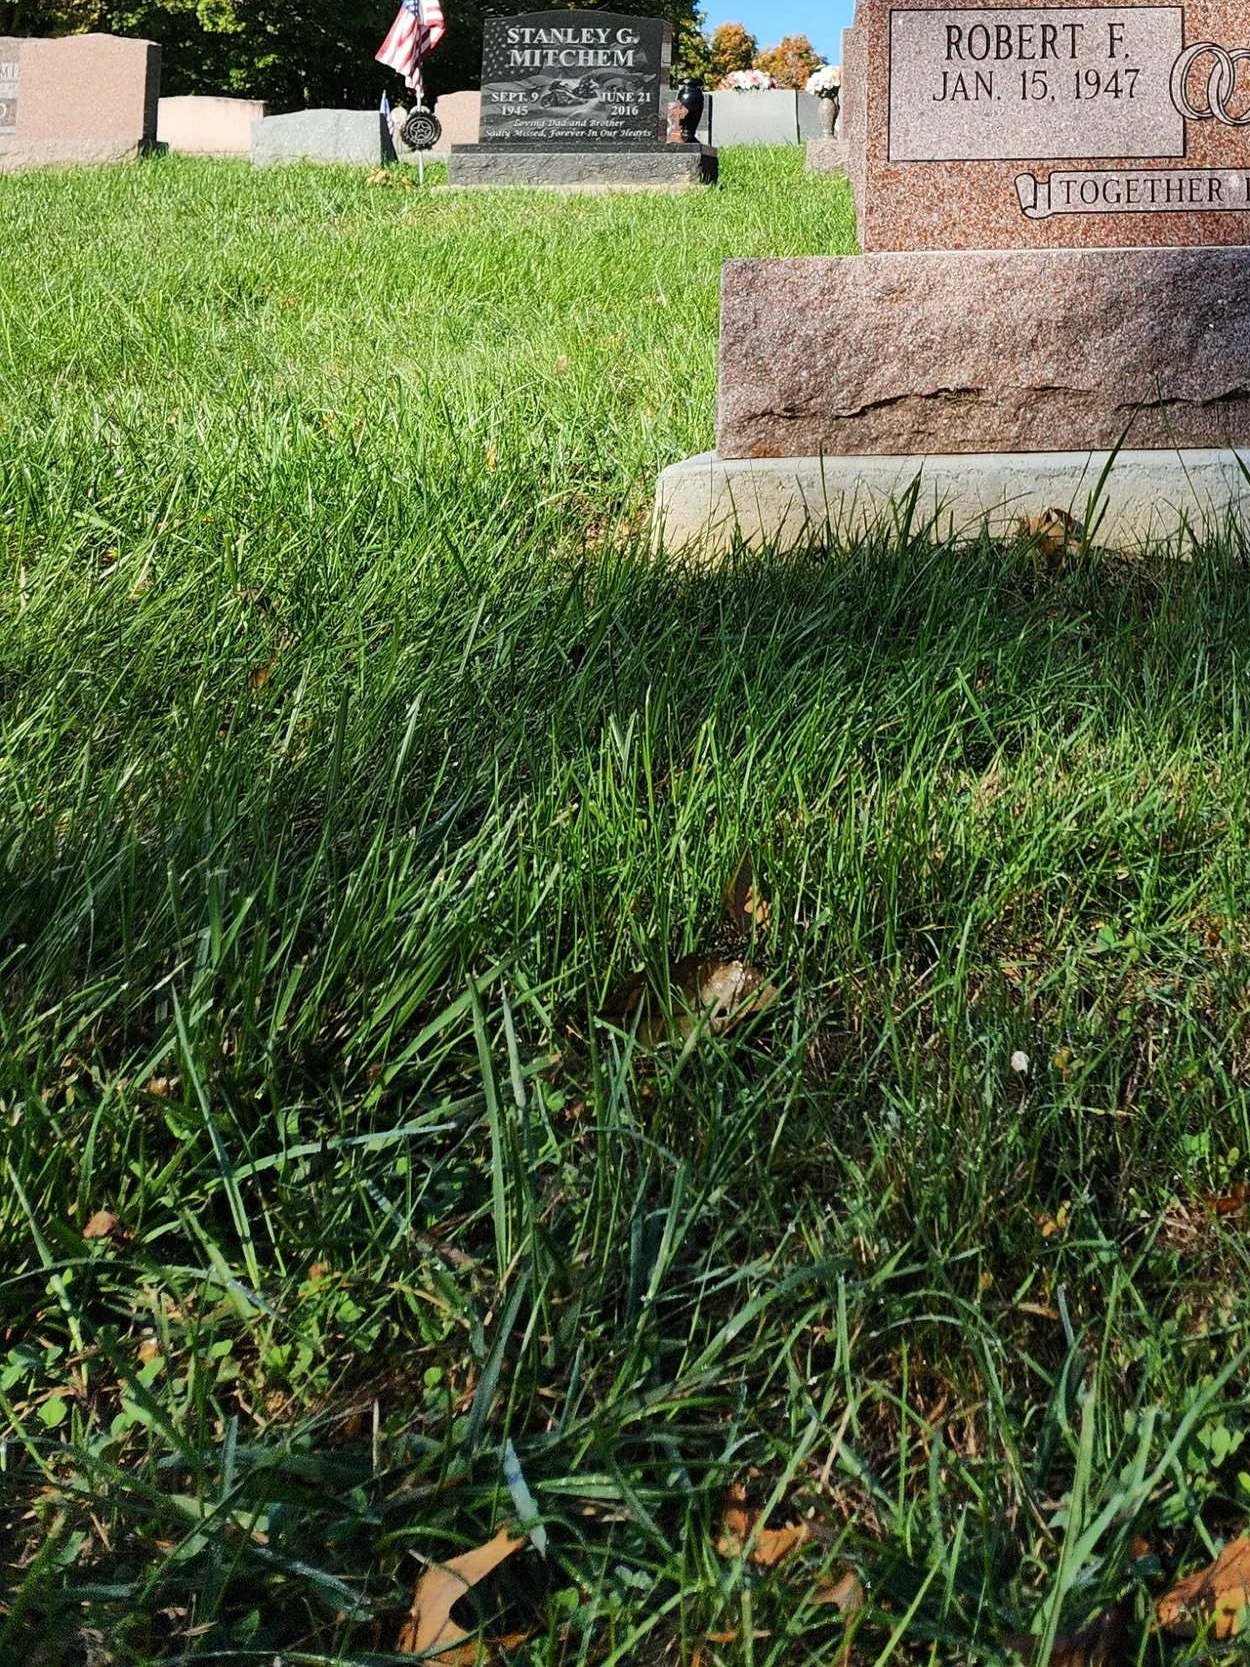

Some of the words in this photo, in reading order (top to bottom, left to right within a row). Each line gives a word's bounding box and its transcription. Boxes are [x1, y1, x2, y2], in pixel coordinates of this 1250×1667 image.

[506, 27, 611, 44] STANLEY
[944, 23, 1084, 61] ROBERT
[1108, 23, 1130, 59] F.
[509, 49, 635, 67] MITCHEM
[932, 70, 1001, 101] JAN.
[1020, 70, 1055, 102] 15,
[1074, 69, 1140, 100] 1947
[491, 92, 528, 102] SEPT.
[531, 92, 539, 102] 9
[600, 91, 635, 102] JUNE
[637, 91, 650, 102] 21
[501, 105, 529, 116] 1945
[611, 105, 639, 116] 2016
[512, 118, 545, 128] Loving
[548, 119, 567, 127] Dad
[568, 119, 587, 127] and
[589, 118, 625, 127] Brother
[600, 129, 617, 137] Our
[618, 129, 651, 137] Hearts
[1059, 177, 1224, 204] TOGETHER
